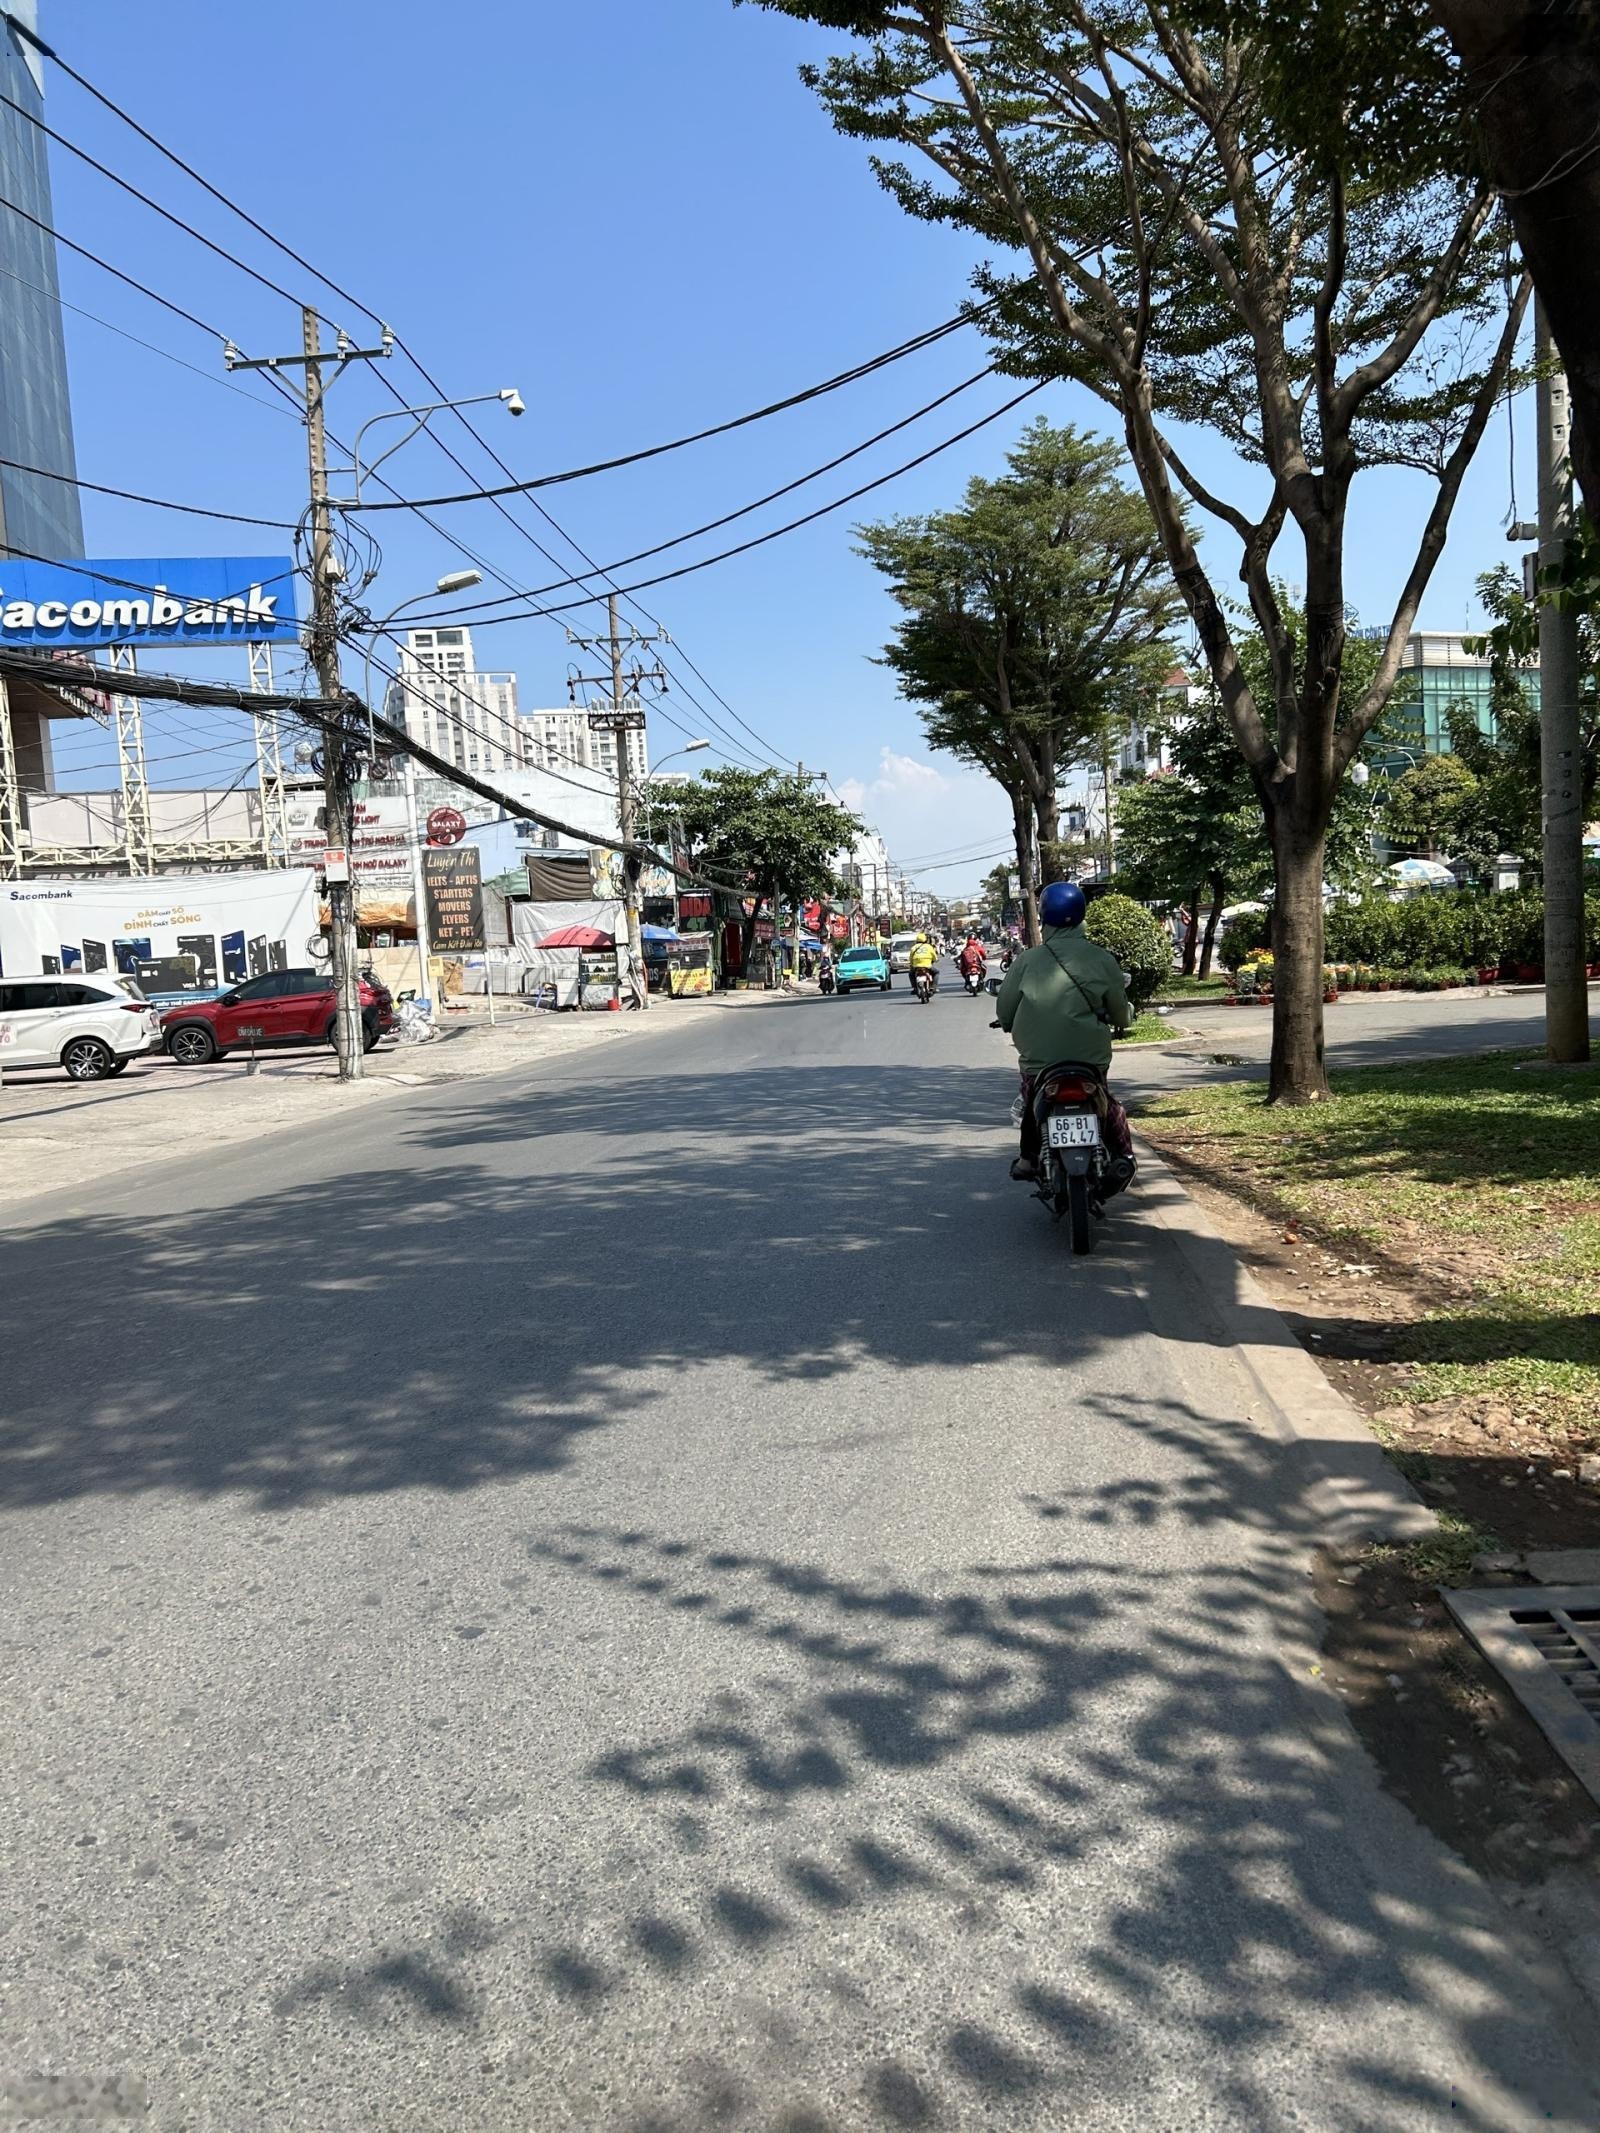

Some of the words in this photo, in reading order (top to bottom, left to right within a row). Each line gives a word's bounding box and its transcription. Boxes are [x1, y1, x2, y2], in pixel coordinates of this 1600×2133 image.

[0, 582, 278, 628] acombank
[431, 820, 461, 828] GALAXY
[378, 858, 408, 870] GALAXY
[426, 852, 457, 873] Luyện
[460, 851, 476, 868] Thi
[427, 875, 448, 887] IELTS
[455, 874, 478, 886] APTIS
[10, 889, 73, 901] Sacombank
[433, 887, 474, 900] STARTERS
[438, 900, 472, 912] MOVERS
[442, 913, 470, 925] FLYERS
[438, 927, 453, 938] KET
[460, 926, 474, 937] PET
[1055, 1117, 1088, 1131] 66-B1
[1052, 1131, 1095, 1145] 564.47
